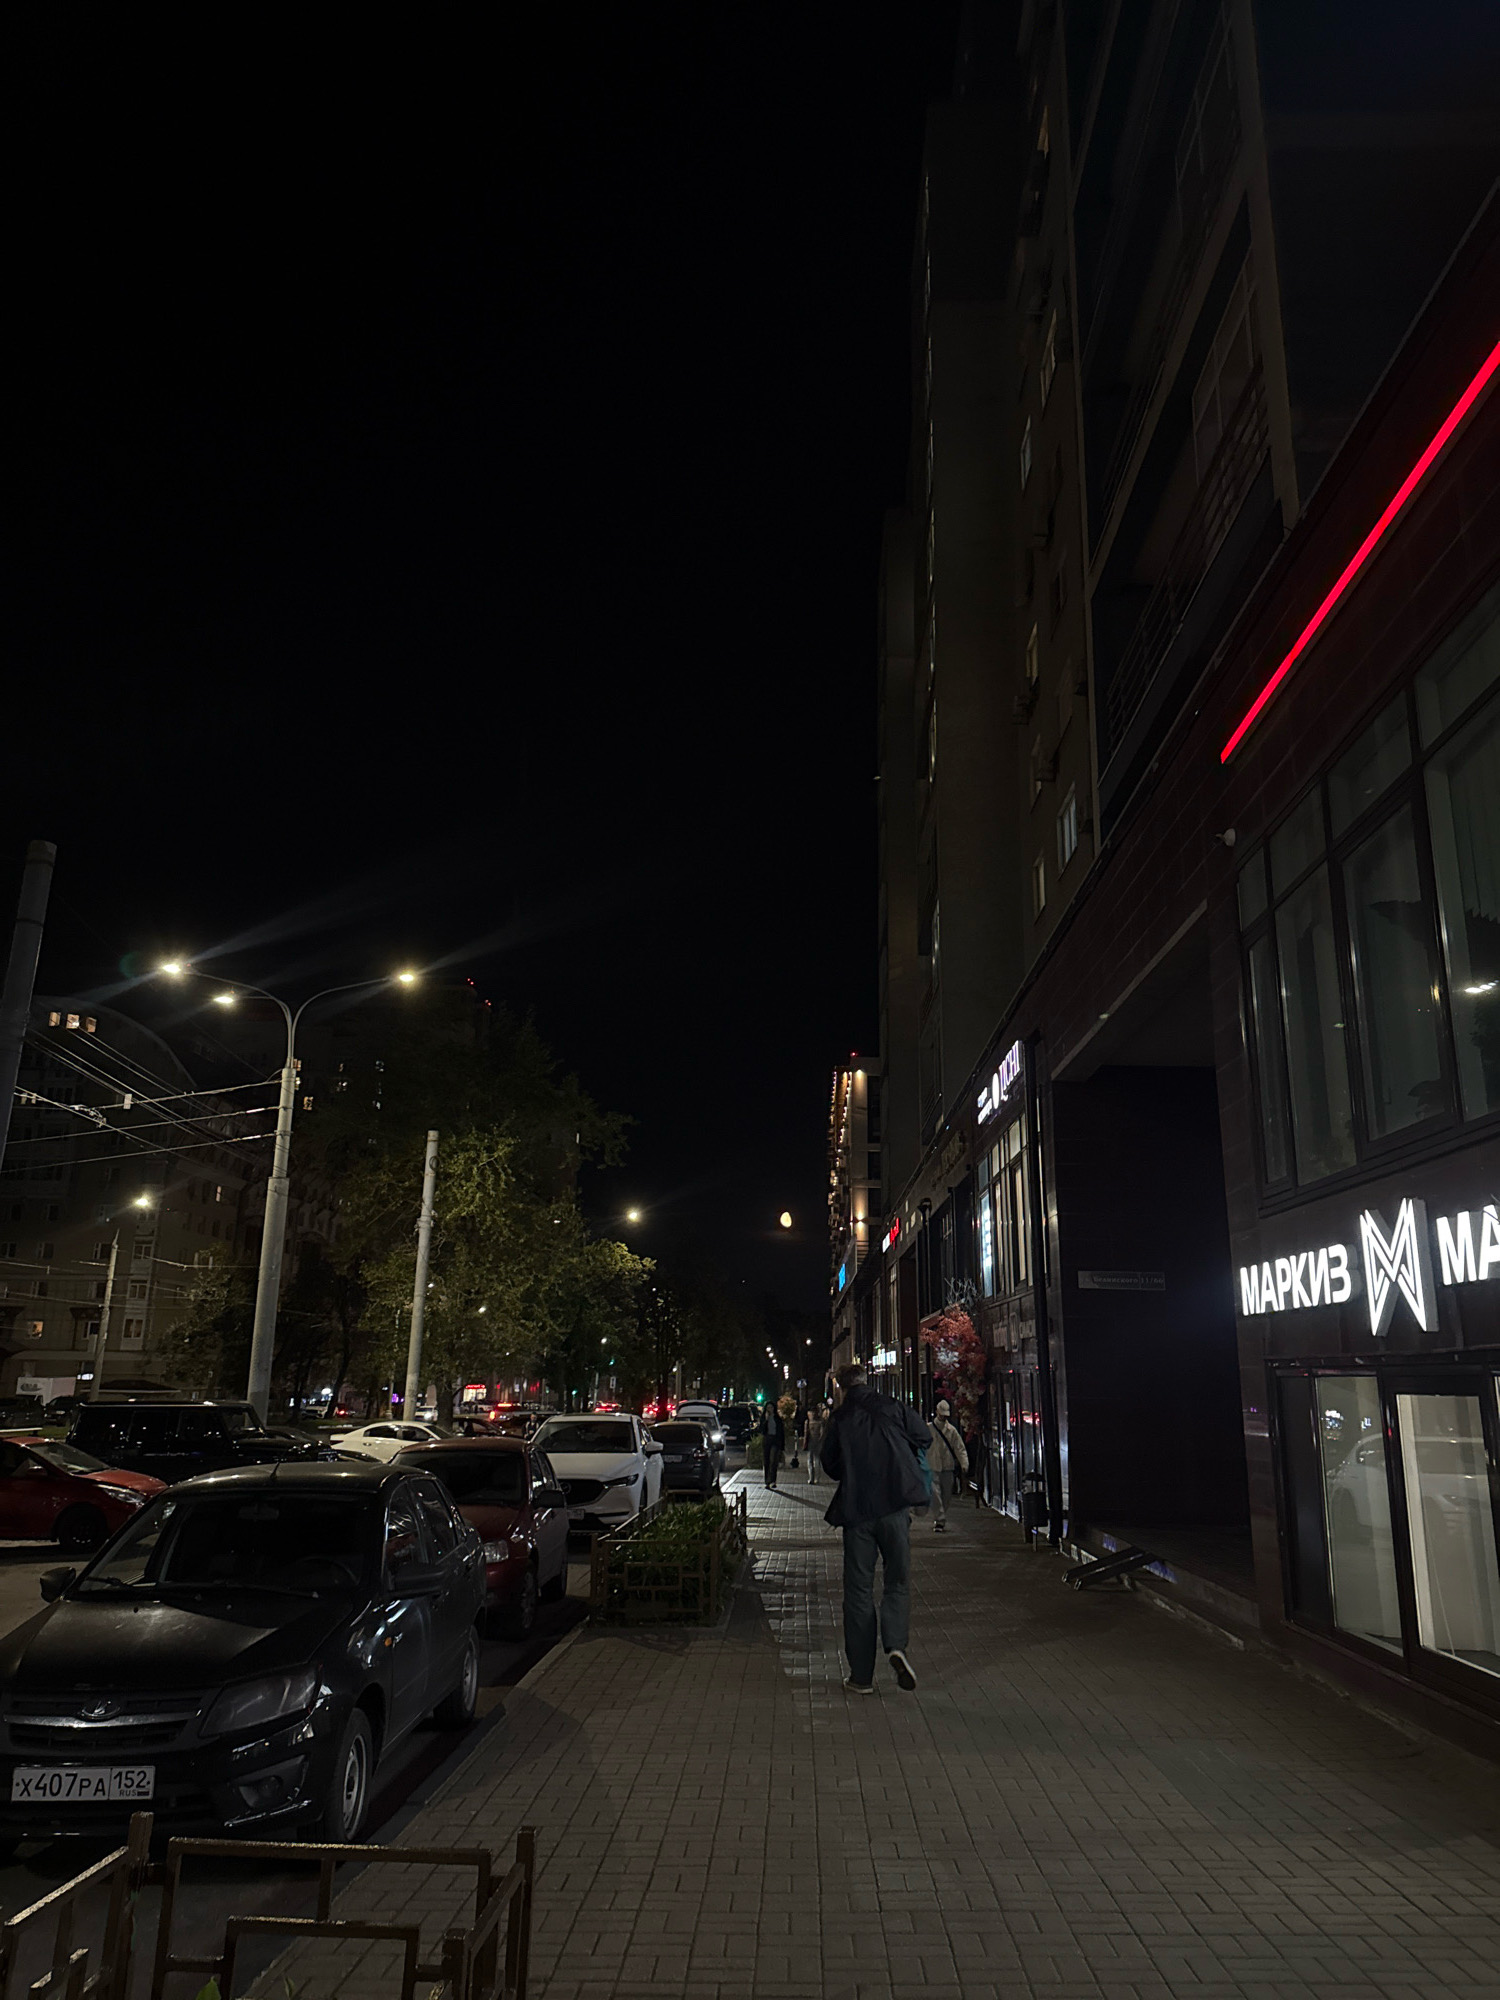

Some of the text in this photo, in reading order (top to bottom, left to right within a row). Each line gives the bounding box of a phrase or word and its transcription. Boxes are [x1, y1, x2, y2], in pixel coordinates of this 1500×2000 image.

[1240, 1243, 1351, 1316] МАРКИЗ
[19, 1770, 147, 1797] Х407РА 152
